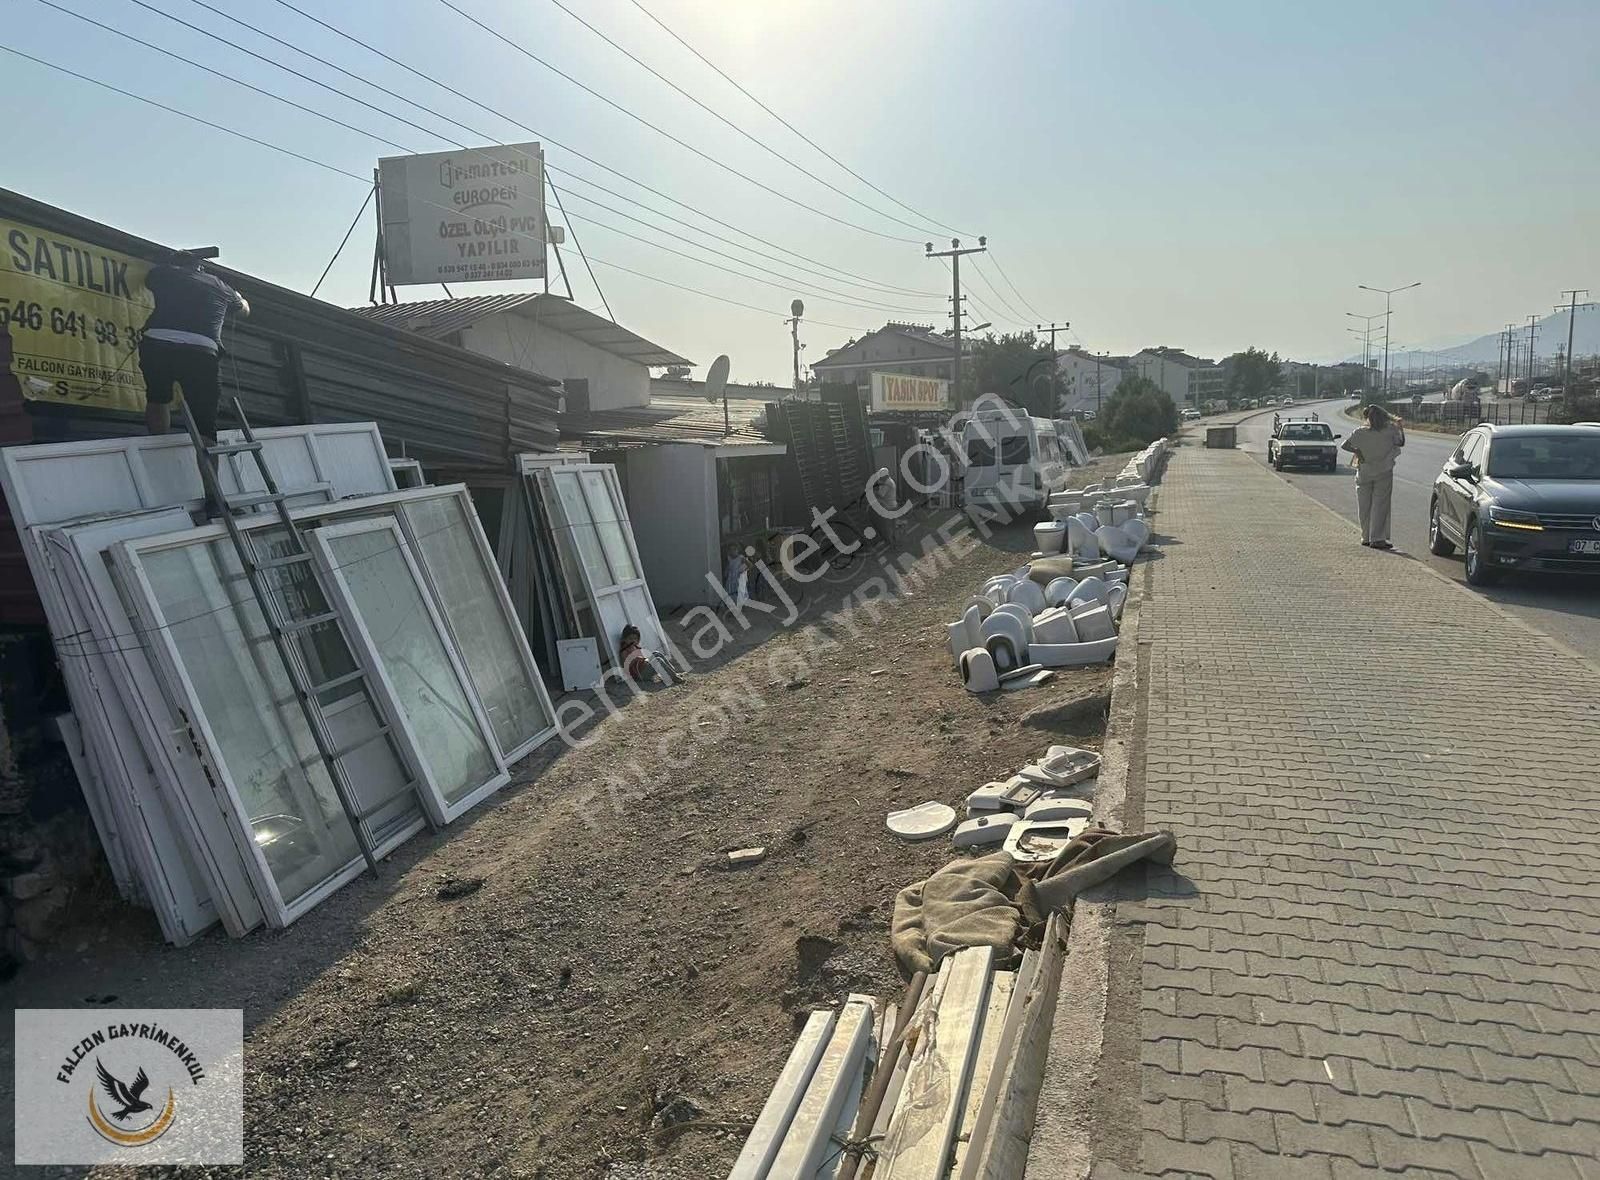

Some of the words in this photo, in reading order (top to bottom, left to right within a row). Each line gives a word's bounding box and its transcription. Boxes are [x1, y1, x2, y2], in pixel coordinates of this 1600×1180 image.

[453, 185, 518, 205] EUROPEN
[439, 220, 471, 239] ÖZEL
[510, 216, 536, 232] PVC
[457, 239, 519, 258] YAPILIR
[8, 229, 132, 300] SATILIK
[0, 297, 43, 331] 546
[50, 306, 87, 340] 641
[17, 357, 65, 376] FALCON
[1575, 540, 1587, 550] 07
